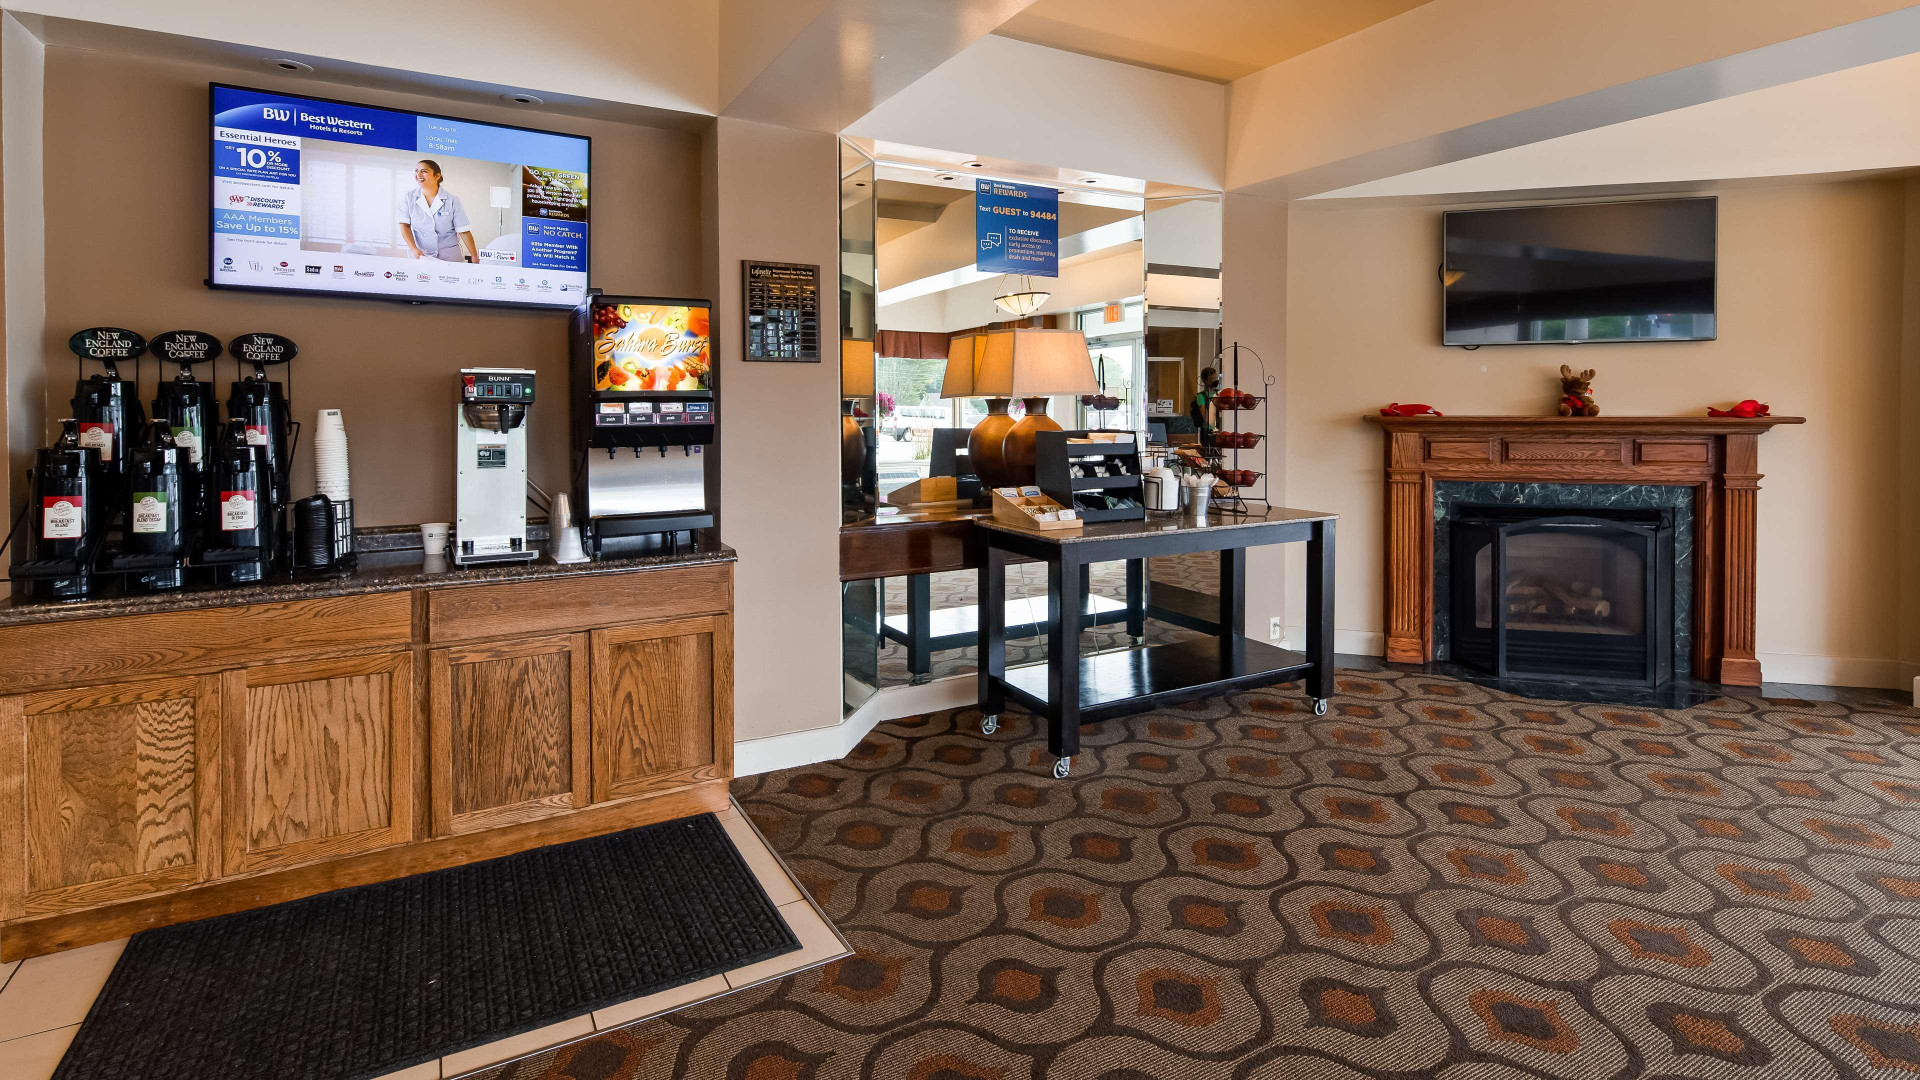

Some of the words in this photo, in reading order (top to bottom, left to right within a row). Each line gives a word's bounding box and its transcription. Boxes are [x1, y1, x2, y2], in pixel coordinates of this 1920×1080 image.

[263, 107, 290, 122] BW
[300, 112, 325, 124] Best
[309, 123, 331, 132] Hotels
[338, 127, 363, 136] Resorts
[219, 130, 262, 143] Essential
[264, 135, 297, 147] Heroes
[428, 142, 455, 151] 8:58am
[236, 147, 281, 168] 10%
[993, 187, 1027, 199] REWARDS
[250, 196, 286, 205] DISCOUNTS
[252, 202, 284, 210] REWARDS
[223, 212, 245, 221] AAA
[248, 215, 293, 225] Members
[992, 206, 1021, 216] GUEST
[1030, 210, 1056, 221] 94484
[216, 220, 243, 230] Save
[245, 223, 261, 233] Up
[264, 225, 275, 233] to
[278, 226, 299, 235] 15%
[543, 229, 556, 237] NO
[1017, 229, 1039, 237] RECEIVE
[97, 331, 120, 340] NEW
[175, 334, 197, 343] NEW
[253, 336, 274, 345] NEW
[85, 338, 132, 348] ENGLAND
[164, 341, 208, 351] ENGLAND
[598, 327, 659, 355] Sahara
[660, 332, 708, 356] Burst
[89, 347, 128, 357] COFFEE
[243, 343, 284, 353] ENGLAND
[168, 350, 205, 358] COFFEE
[246, 351, 281, 360] COFFEE
